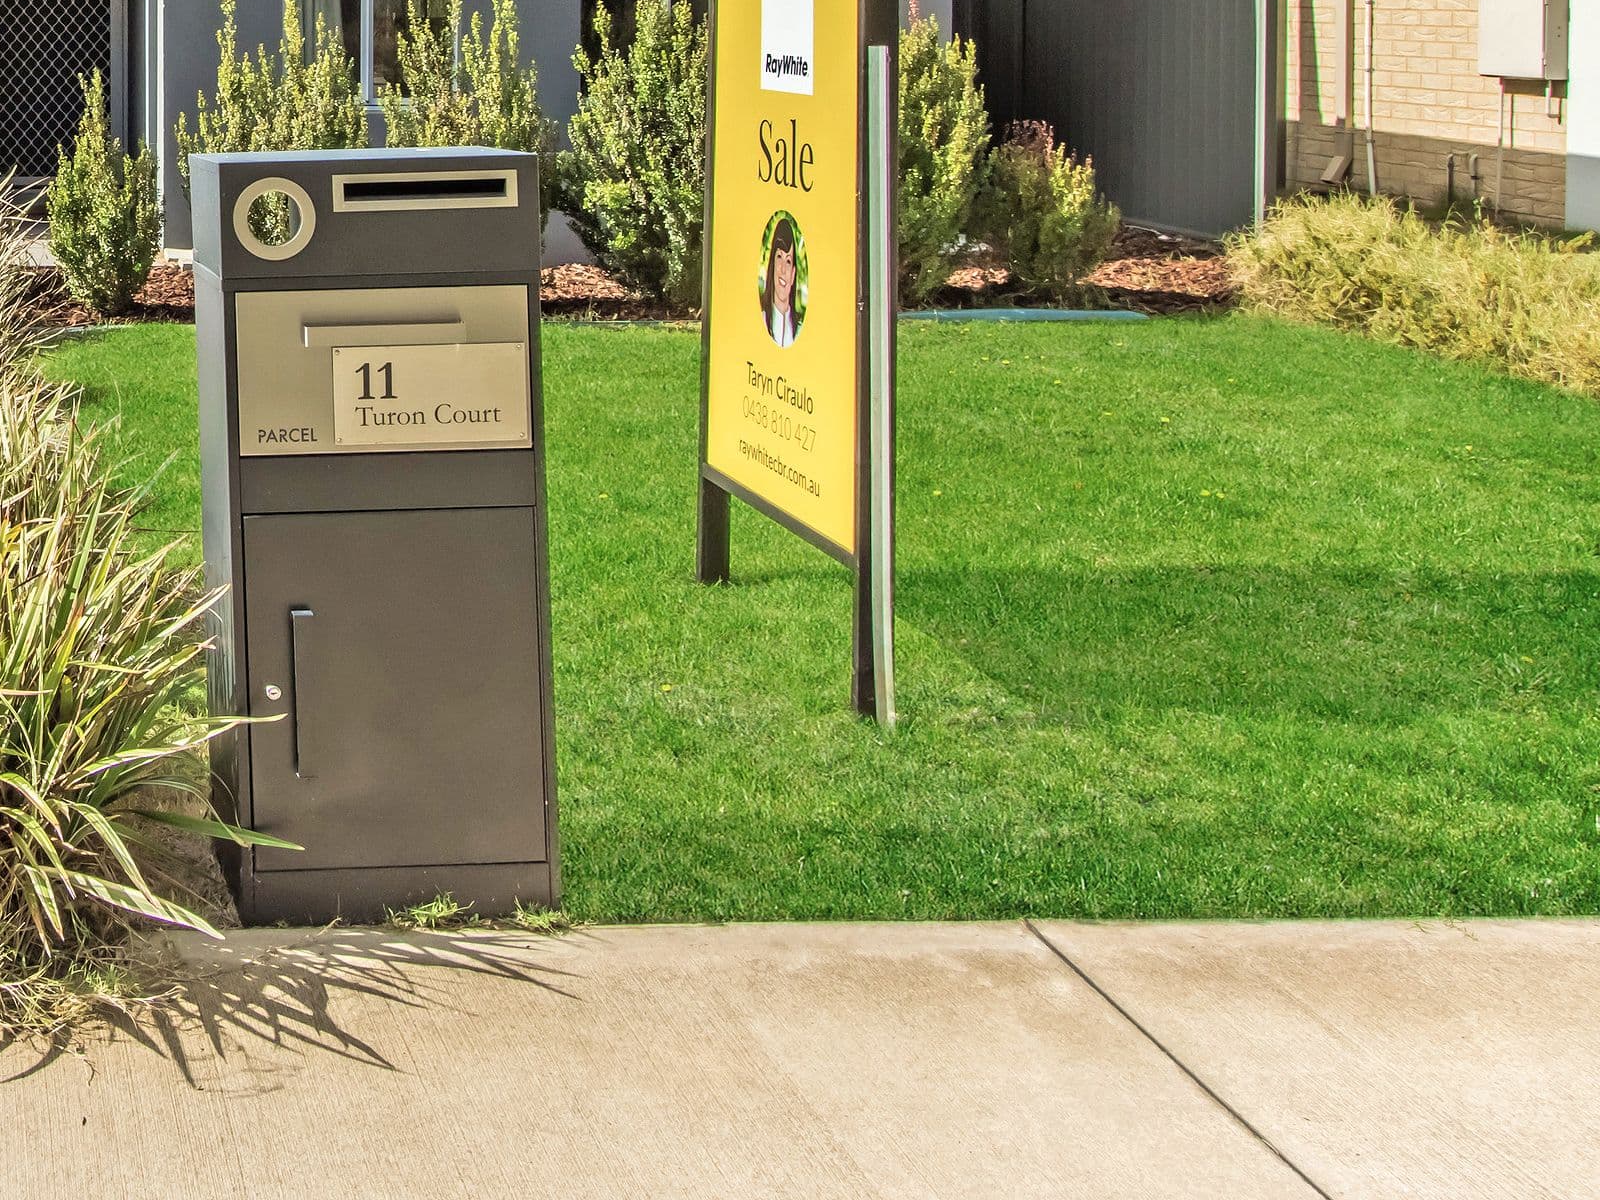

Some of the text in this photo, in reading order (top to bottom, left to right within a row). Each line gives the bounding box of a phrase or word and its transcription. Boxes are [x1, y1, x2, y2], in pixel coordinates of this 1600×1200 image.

[765, 53, 809, 77] RayWhite
[758, 119, 814, 192] Sale
[355, 362, 399, 401] 11
[746, 360, 814, 415] Taryn Ciraulo
[258, 427, 318, 444] PARCEL
[355, 403, 502, 428] Turon Court
[742, 395, 817, 454] 0438 810 427
[739, 439, 820, 497] raywhitecbr.com.au
